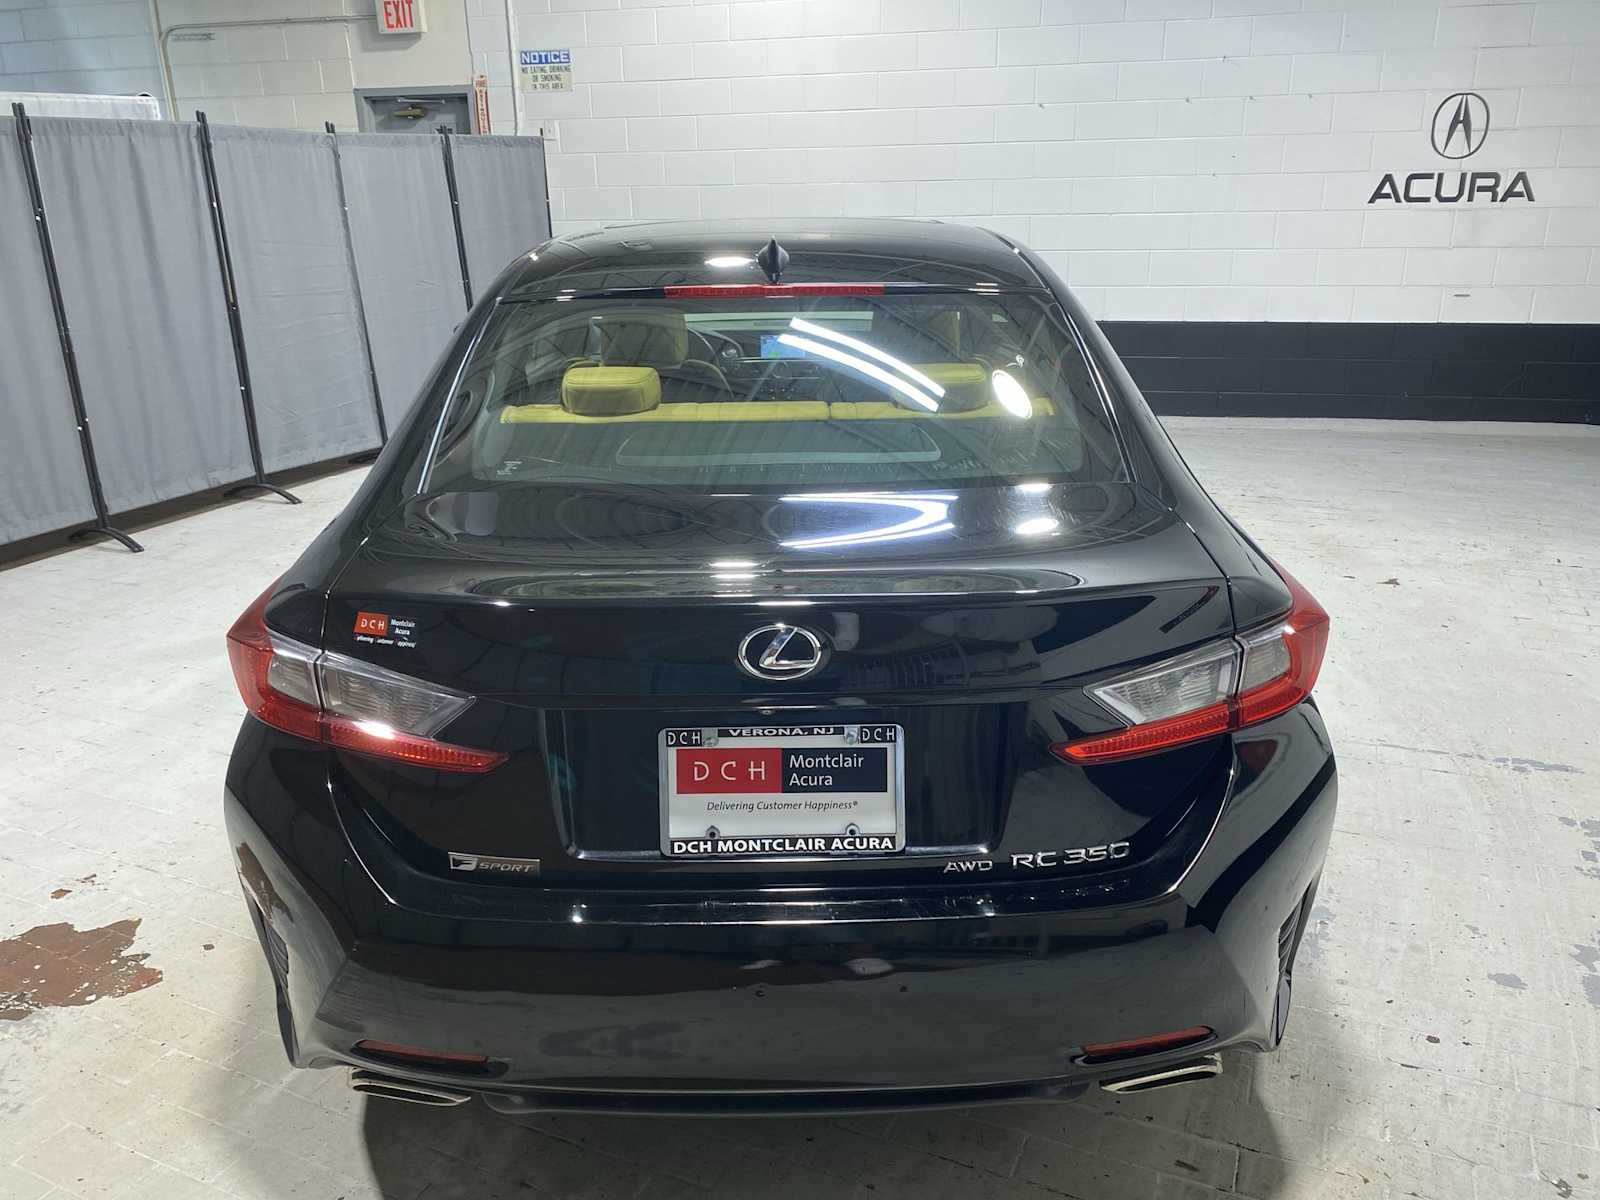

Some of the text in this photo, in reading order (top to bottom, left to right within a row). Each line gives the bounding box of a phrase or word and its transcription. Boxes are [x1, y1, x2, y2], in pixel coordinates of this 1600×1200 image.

[384, 0, 414, 29] EXIT
[521, 51, 570, 64] NOTICE
[1368, 171, 1536, 204] ACURA
[360, 619, 384, 630] DCH
[667, 731, 701, 745] DCH
[728, 727, 835, 737] VERONA, NJ
[862, 727, 896, 741] DCH
[789, 754, 864, 769] Montclair
[693, 760, 766, 782] DCH
[789, 773, 833, 787] Acura
[706, 801, 755, 812] Delivering
[756, 801, 802, 811] Customer
[674, 837, 894, 854] DCH MONTCLAIR ACURA
[1010, 842, 1130, 869] RC 350
[479, 861, 535, 873] SPORT
[943, 860, 994, 874] AWD
